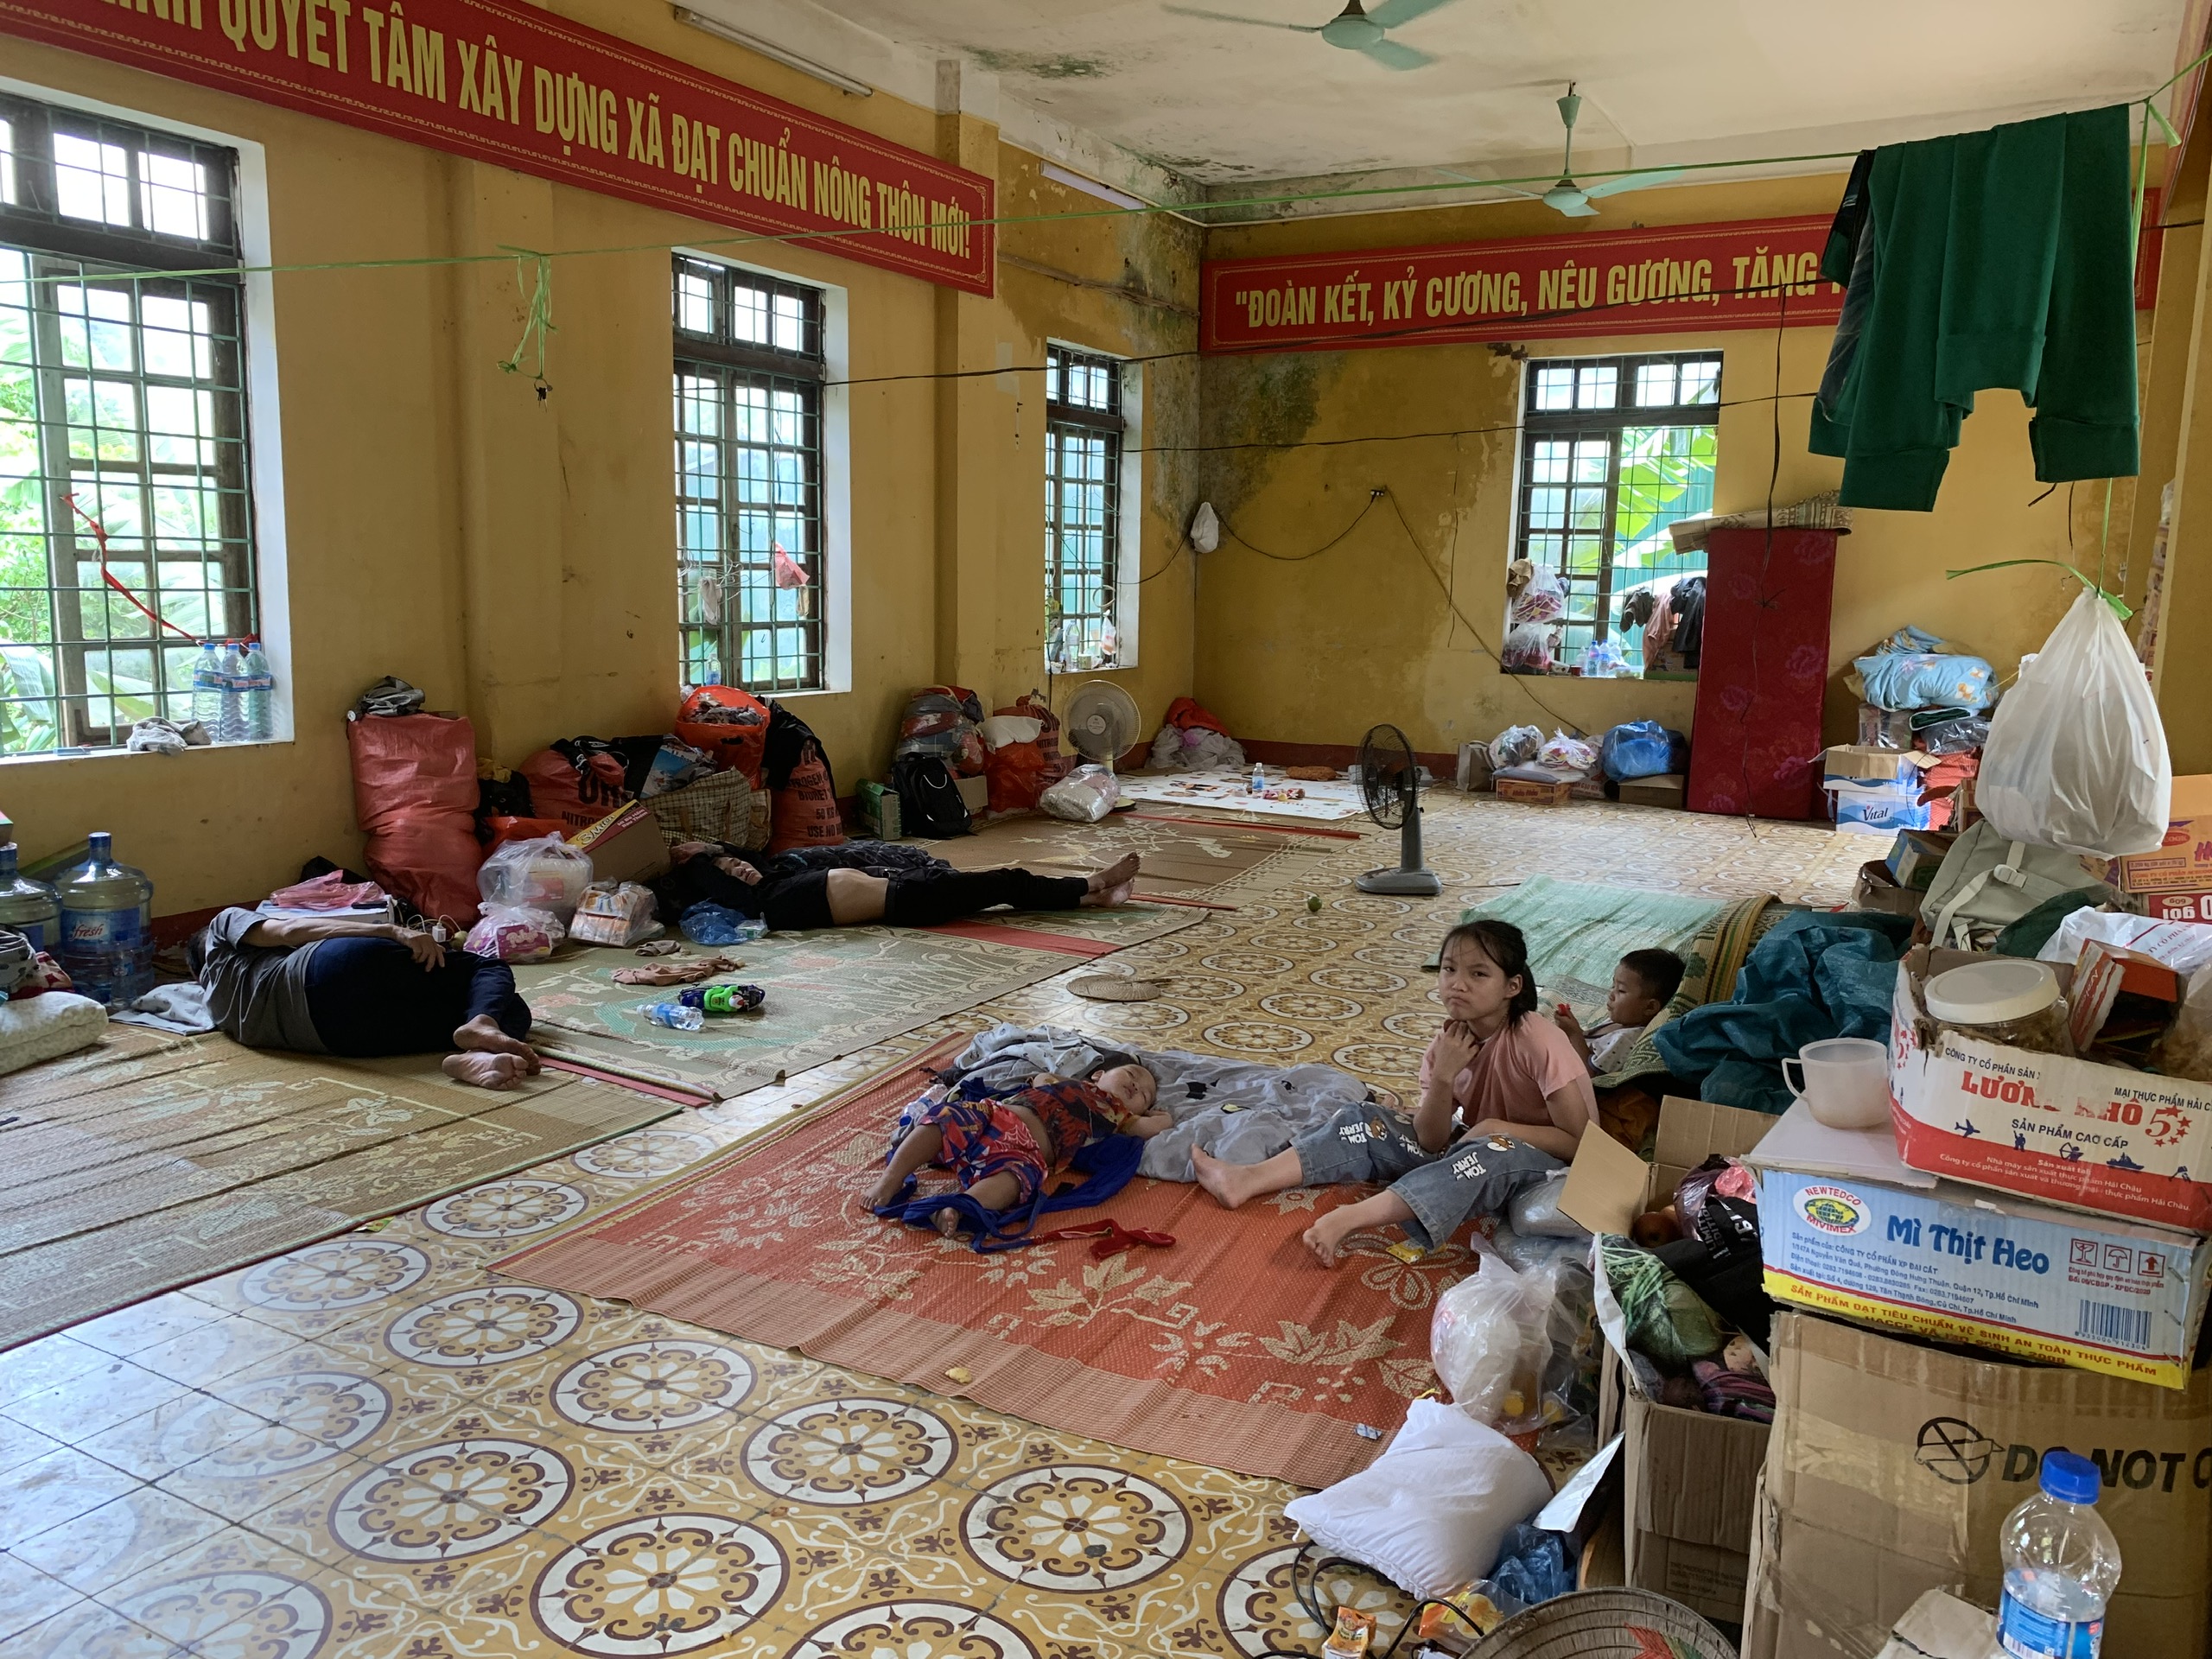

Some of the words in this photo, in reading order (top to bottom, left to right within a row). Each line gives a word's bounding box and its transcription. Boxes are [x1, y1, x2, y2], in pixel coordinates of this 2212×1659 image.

[363, 1, 446, 104] TÂM
[456, 34, 523, 124] XÂY
[534, 66, 618, 156] DỰNG
[627, 92, 665, 169] XÃ
[671, 113, 721, 194] ĐẠT
[728, 126, 807, 211] CHUẨN
[813, 156, 872, 231] NÔNG
[876, 180, 926, 246] THÔN
[931, 196, 970, 258] MỚI!
[1236, 272, 1316, 327] "ĐOÀN
[1324, 267, 1374, 327] KẾT,
[1383, 265, 1418, 320] KỶ
[1426, 269, 1528, 318] CƯƠNG,
[1552, 261, 1598, 310] NÊU
[1606, 257, 1720, 306] GƯƠNG,
[1732, 246, 1819, 298] TĂNG
[1863, 805, 1889, 821] Vital
[70, 924, 104, 940] fresh
[1945, 1047, 1966, 1062] CÔNG
[1967, 1055, 1978, 1065] TY
[1979, 1058, 1991, 1070] CỔ
[2018, 1065, 2035, 1080] SẢN
[2113, 1087, 2131, 1099] MẠI
[2133, 1090, 2157, 1103] THỰC
[2158, 1092, 2184, 1107] PHẨM
[2187, 1097, 2203, 1110] HẢI
[1338, 1122, 1364, 1136] JERRY
[1348, 1132, 1367, 1145] TOM
[2012, 1118, 2036, 1132] SẢN
[2038, 1123, 2073, 1141] PHẨM
[2103, 1135, 2129, 1149] CẤP
[1451, 1151, 1478, 1174] JERRY
[1940, 1154, 1961, 1165] Công
[1463, 1163, 1487, 1180] TOM
[1986, 1155, 2003, 1166] Nhà
[2120, 1182, 2142, 1193] Châu
[1805, 1186, 1861, 1206] NEWTEDCO
[1806, 1214, 1857, 1234] MIVIMEX
[1835, 1244, 1855, 1255] CÔNG
[1886, 1215, 1923, 1248] Mì
[1928, 1224, 1986, 1265] Thịt
[1993, 1237, 2050, 1275] Heo
[1790, 1283, 1813, 1300] SẢN
[1853, 1302, 1877, 1315] ĐẠT
[1881, 1308, 1908, 1321] TIÊU
[1958, 1325, 1975, 1337] VỆ
[1980, 1331, 2011, 1344] SINH
[2014, 1338, 2032, 1348] AN
[2037, 1341, 2072, 1357] TOÀN
[2076, 1351, 2112, 1365] THỰC
[2116, 1358, 2158, 1376] PHẨM
[1999, 1314, 2017, 1324] Minh
[2089, 1448, 2187, 1493] NOT
